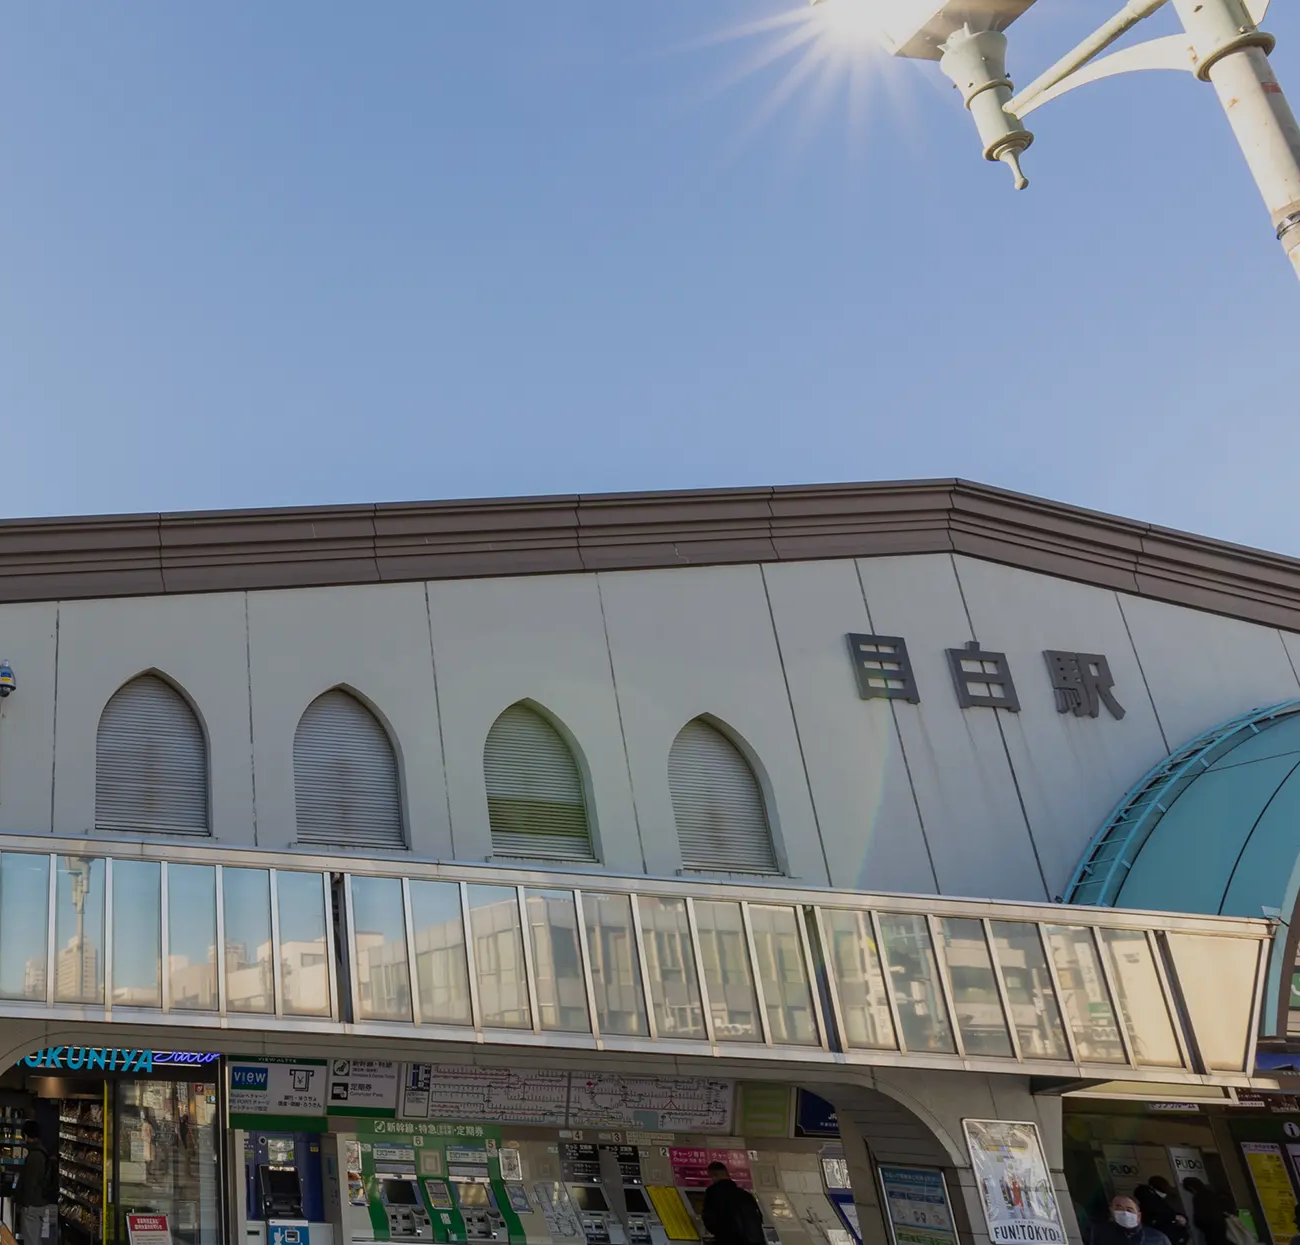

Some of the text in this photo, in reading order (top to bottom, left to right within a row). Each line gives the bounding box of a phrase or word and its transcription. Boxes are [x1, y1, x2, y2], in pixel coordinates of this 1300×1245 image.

[844, 632, 1127, 722] 目白駅
[17, 1045, 152, 1073] OKUNIYA
[350, 1083, 372, 1091] 定期券
[574, 1131, 580, 1139] 4
[614, 1133, 620, 1142] 3
[415, 1136, 422, 1145] 6
[488, 1140, 494, 1148] 5
[661, 1147, 667, 1156] 2
[1109, 1163, 1139, 1175] PUDO
[1175, 1159, 1203, 1170] PUDO
